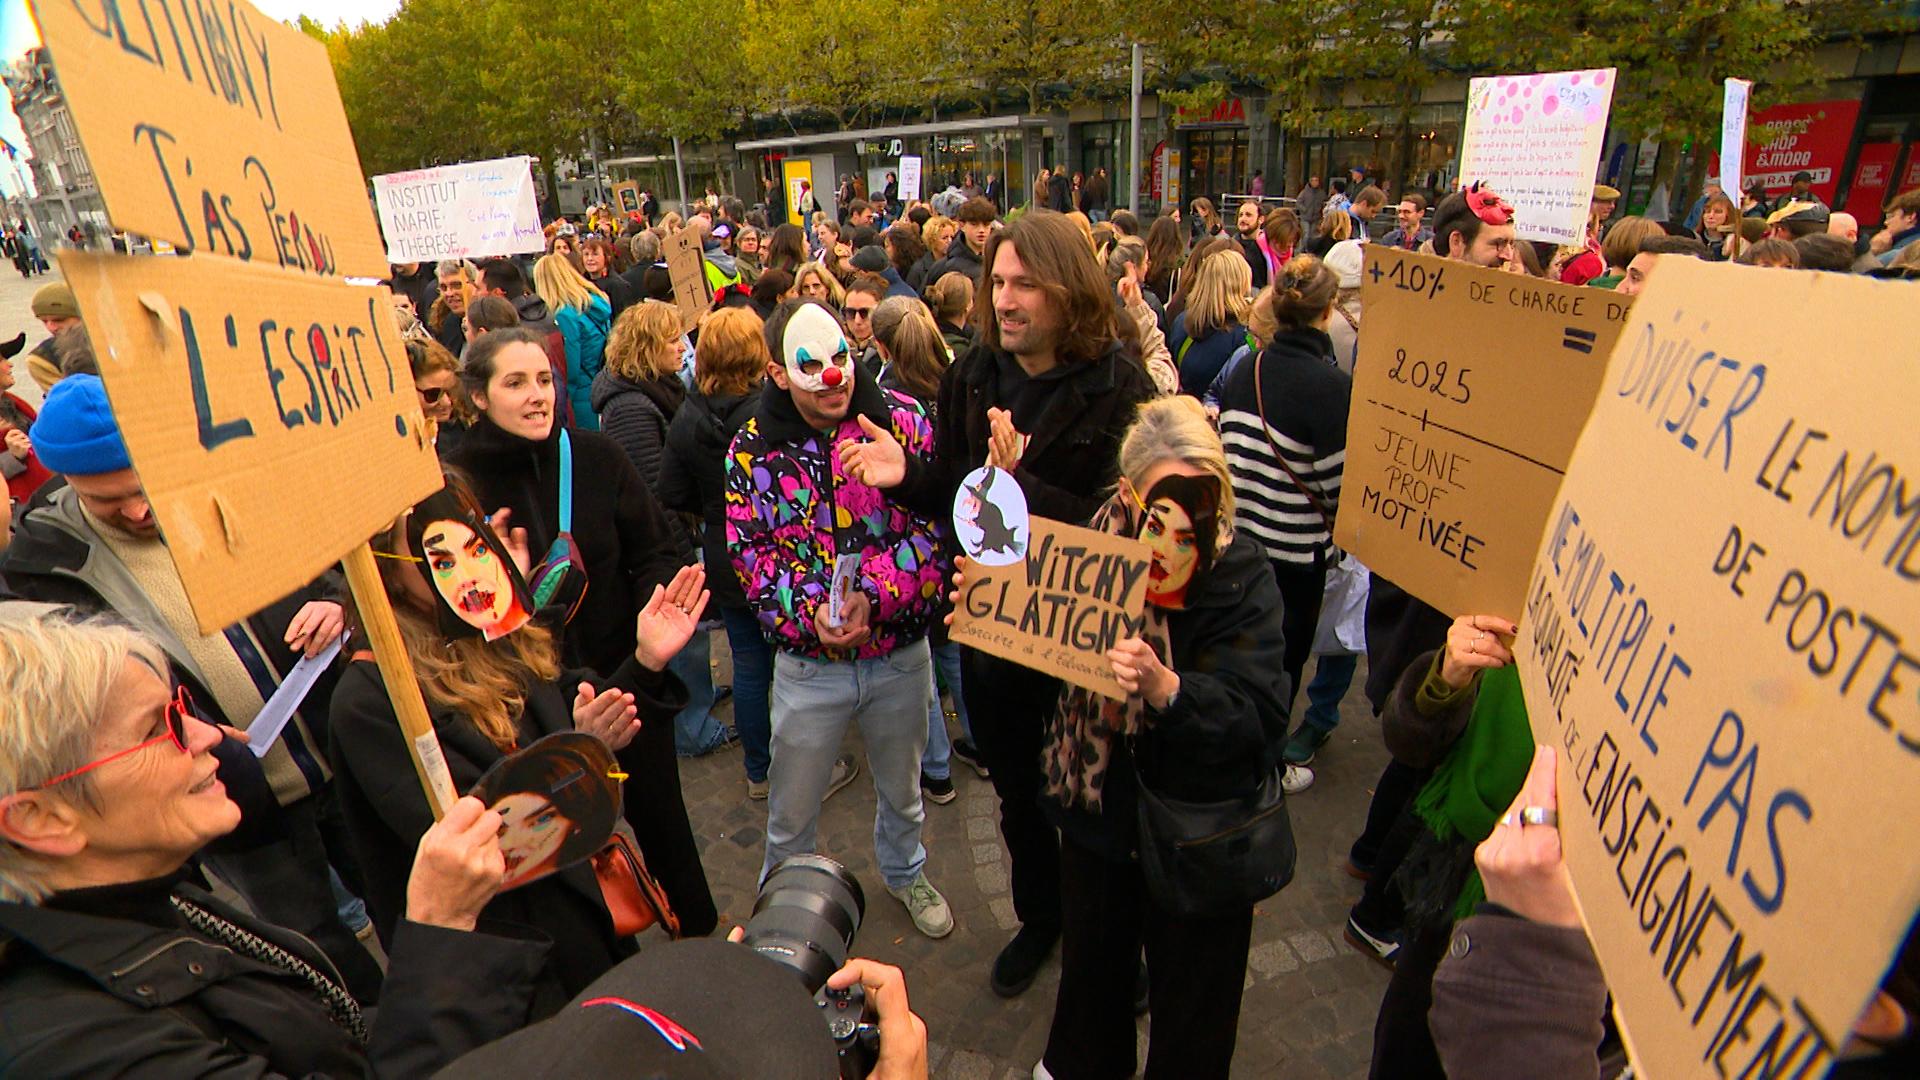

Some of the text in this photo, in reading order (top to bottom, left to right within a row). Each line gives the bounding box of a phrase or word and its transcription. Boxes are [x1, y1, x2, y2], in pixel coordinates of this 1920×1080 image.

[887, 138, 903, 157] JD
[243, 155, 337, 277] PERDU
[386, 180, 460, 210] INSTITUT
[1368, 259, 1446, 300] +10%
[1469, 281, 1495, 304] DE
[1509, 287, 1585, 317] CHARGE
[1388, 348, 1472, 404] 2025
[1375, 427, 1472, 490] JEUNE
[1384, 465, 1449, 510] PROF
[1755, 417, 1829, 504] LE
[1712, 523, 1767, 599] DE
[1683, 708, 1814, 917] PAS
